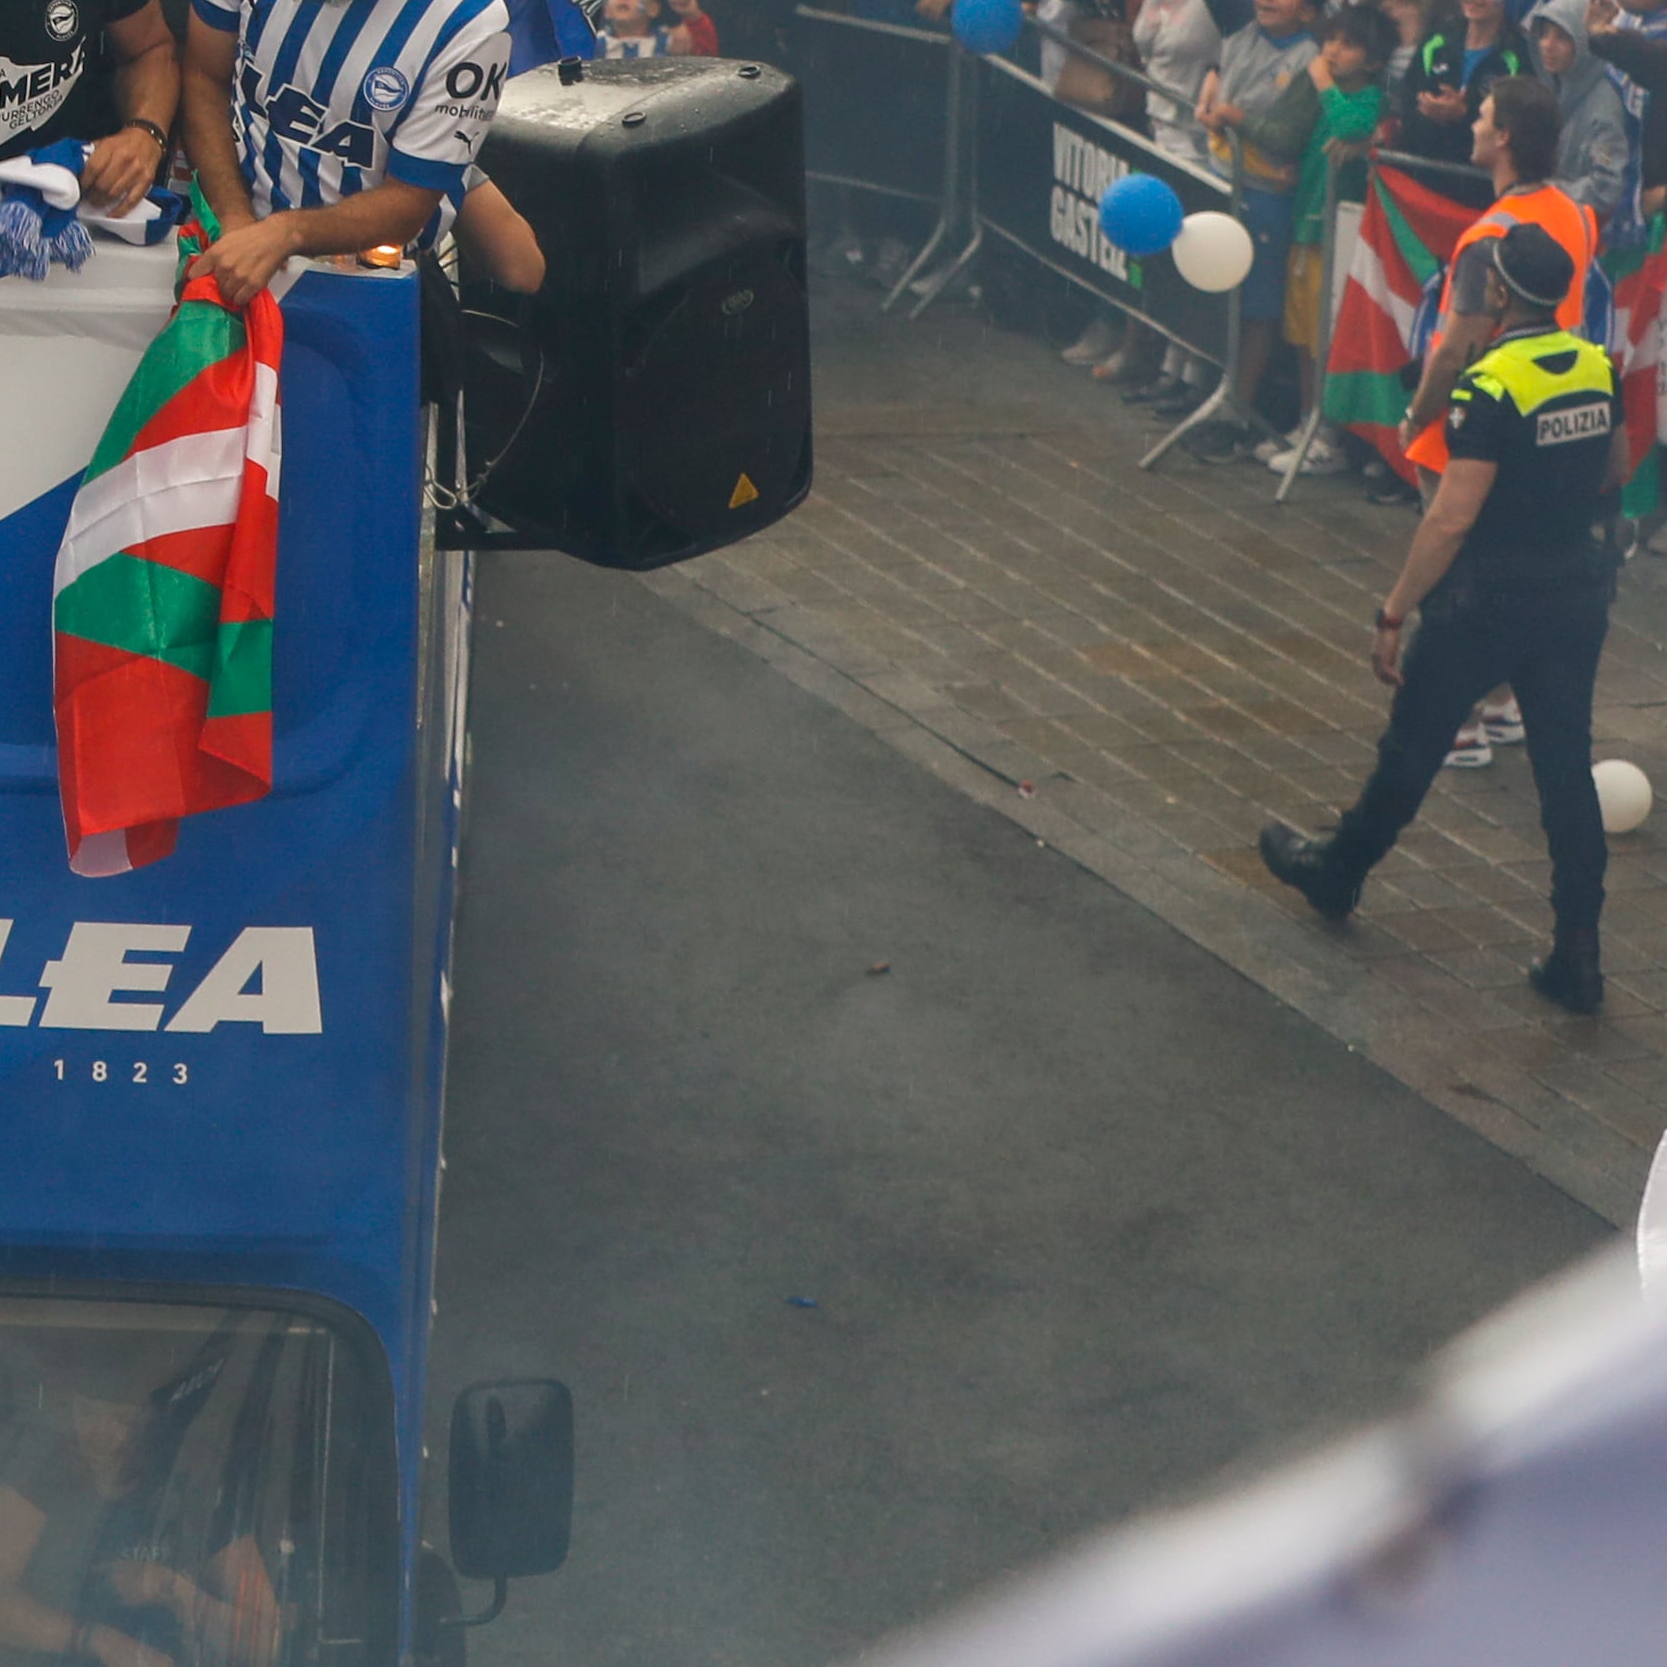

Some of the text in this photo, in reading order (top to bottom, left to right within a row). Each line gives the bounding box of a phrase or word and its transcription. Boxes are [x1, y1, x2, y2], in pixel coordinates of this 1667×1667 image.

[445, 61, 508, 103] OK
[240, 59, 376, 171] LEA
[1538, 406, 1610, 441] POLIZIA
